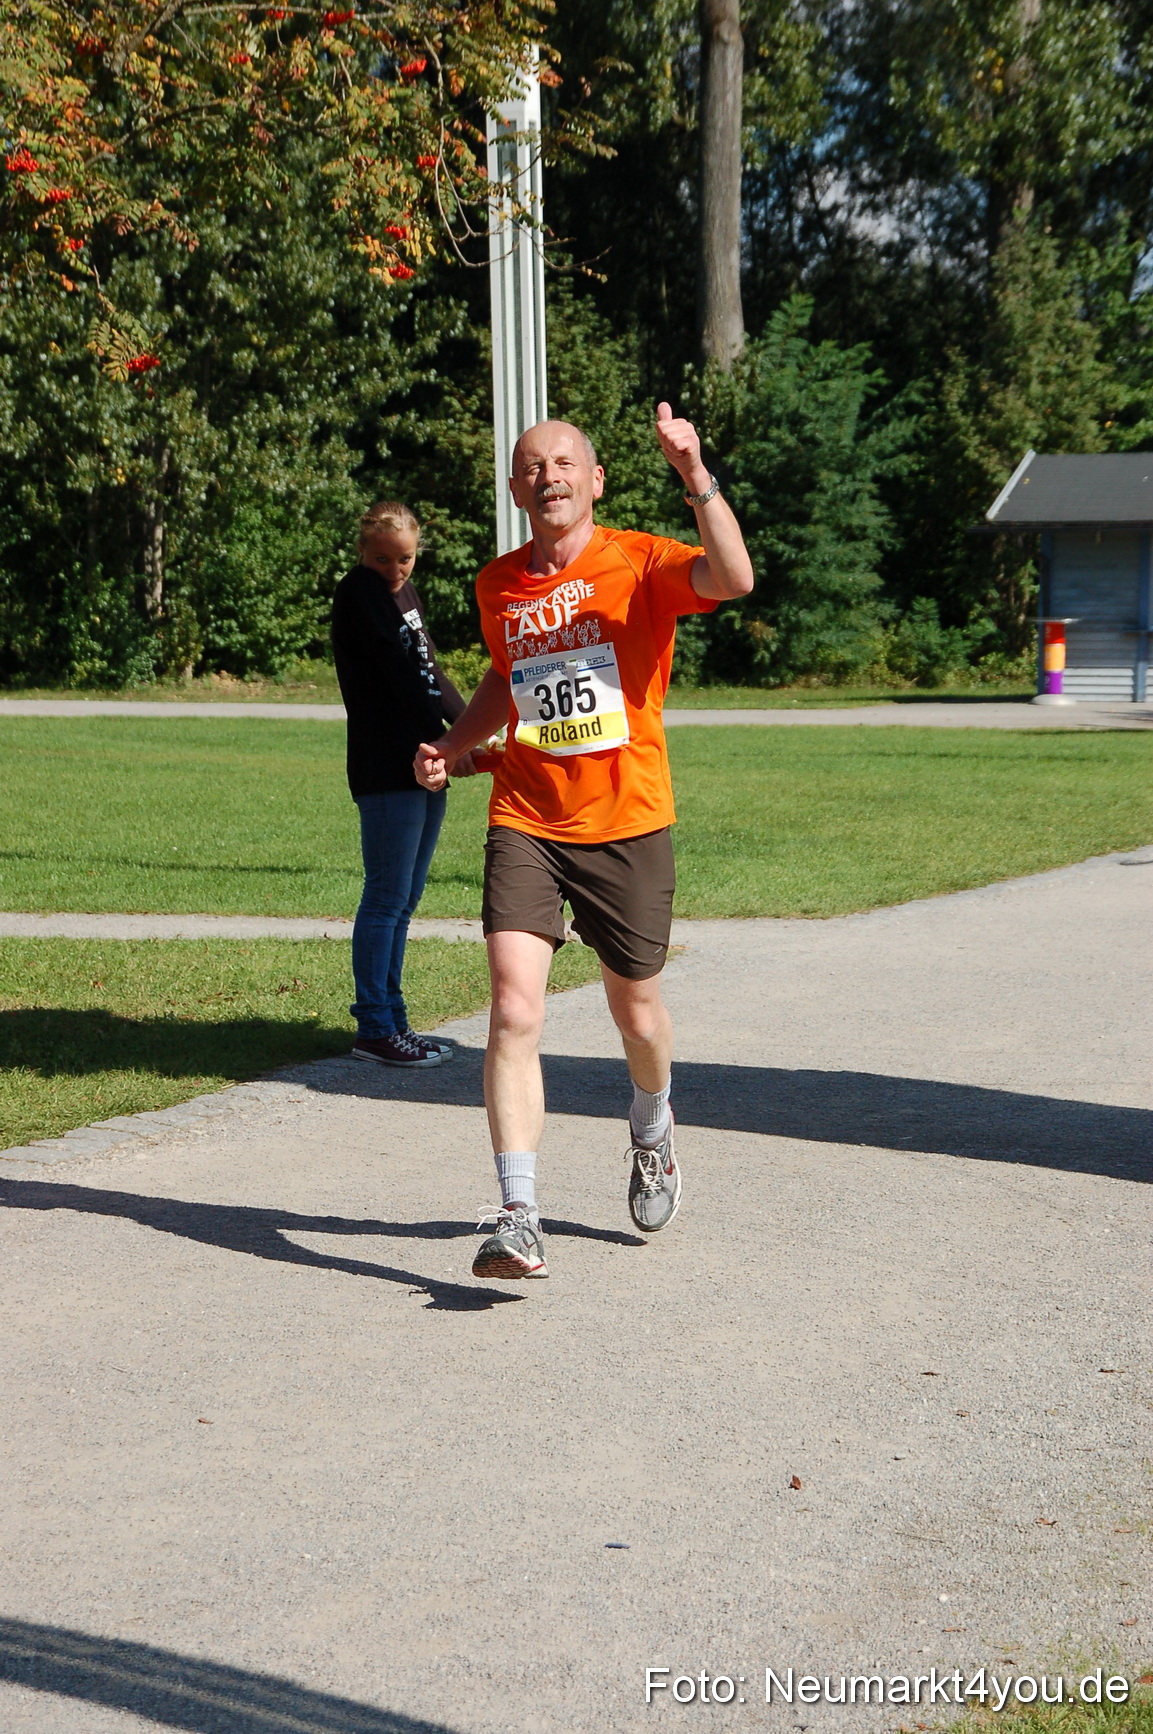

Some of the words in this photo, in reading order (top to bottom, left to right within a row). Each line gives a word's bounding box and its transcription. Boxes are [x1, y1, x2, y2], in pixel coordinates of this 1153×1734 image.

[505, 600, 579, 644] LAUF
[524, 661, 567, 677] PFLEIDERER
[534, 675, 597, 722] 365
[539, 716, 603, 745] Roland
